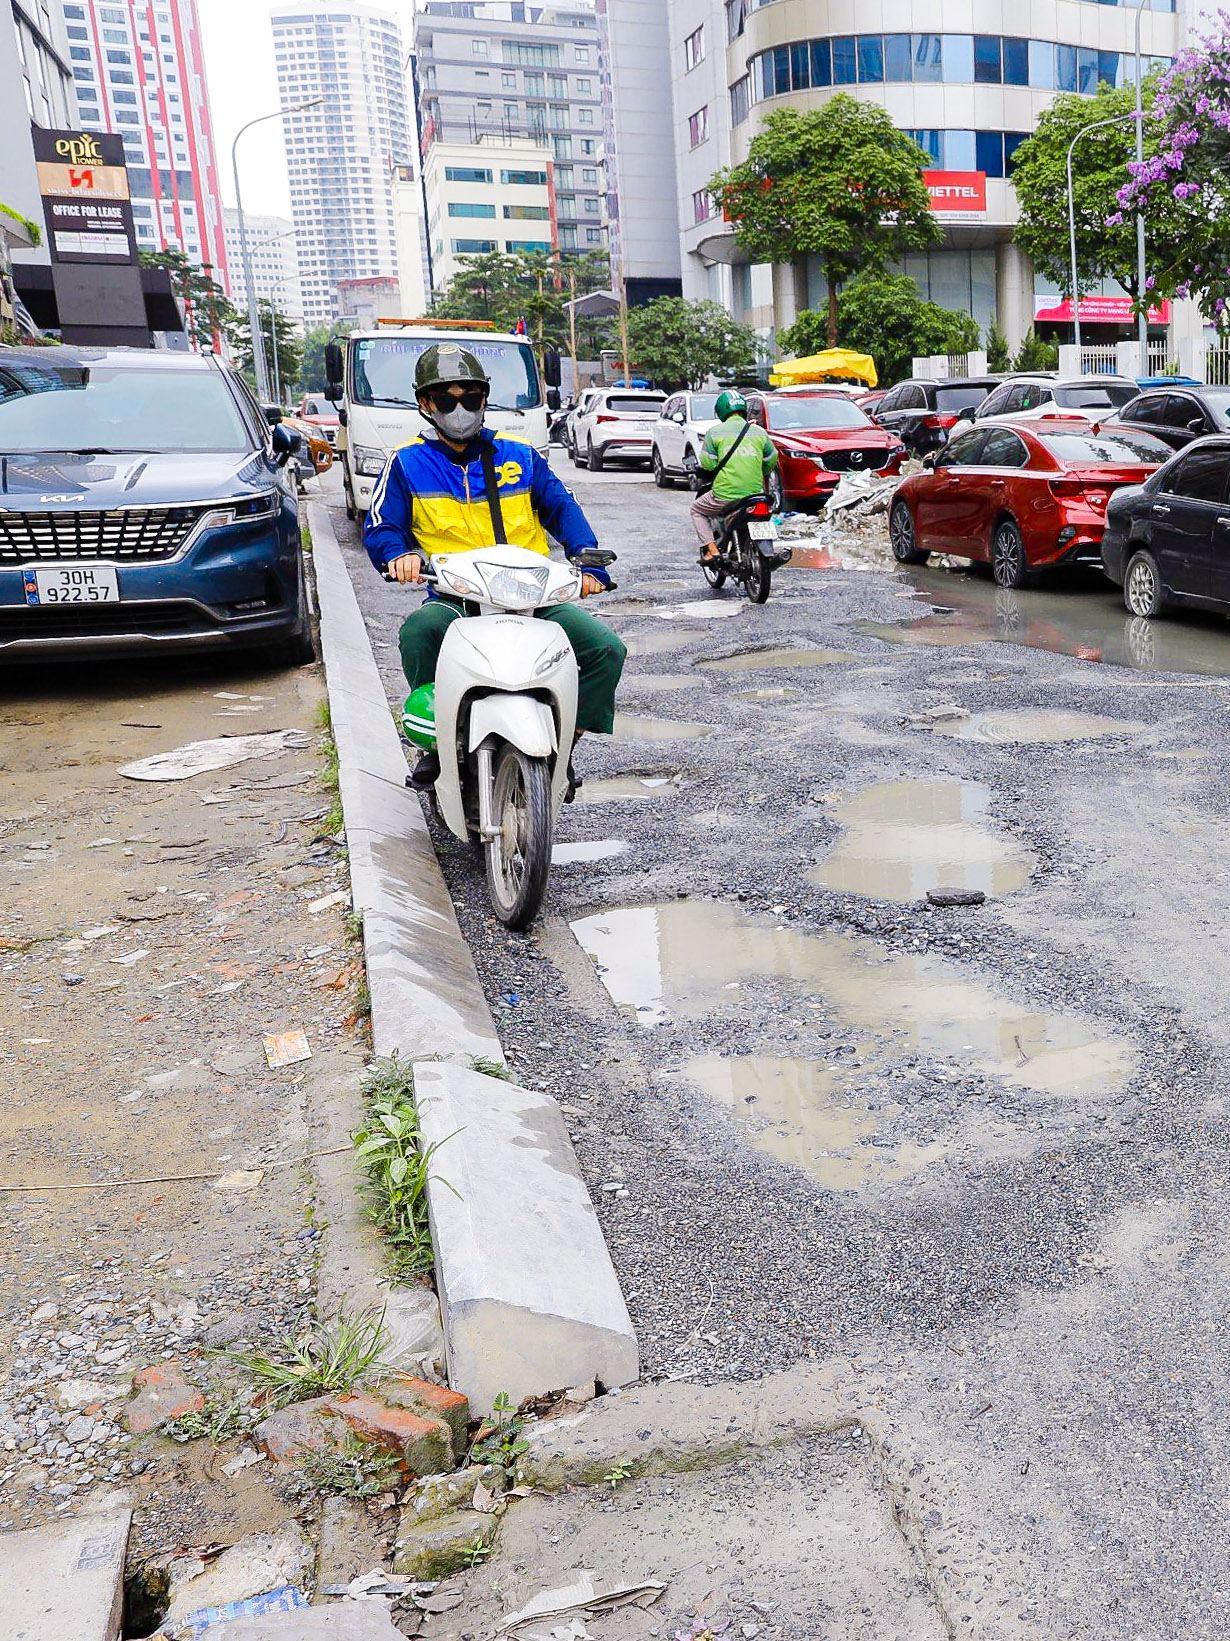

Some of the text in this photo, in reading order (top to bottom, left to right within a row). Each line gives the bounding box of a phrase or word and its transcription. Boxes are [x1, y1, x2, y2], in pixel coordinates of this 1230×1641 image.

[52, 205, 122, 218] OFFICE FOR LEASE
[60, 571, 94, 585] 30H
[47, 587, 110, 601] 922.57
